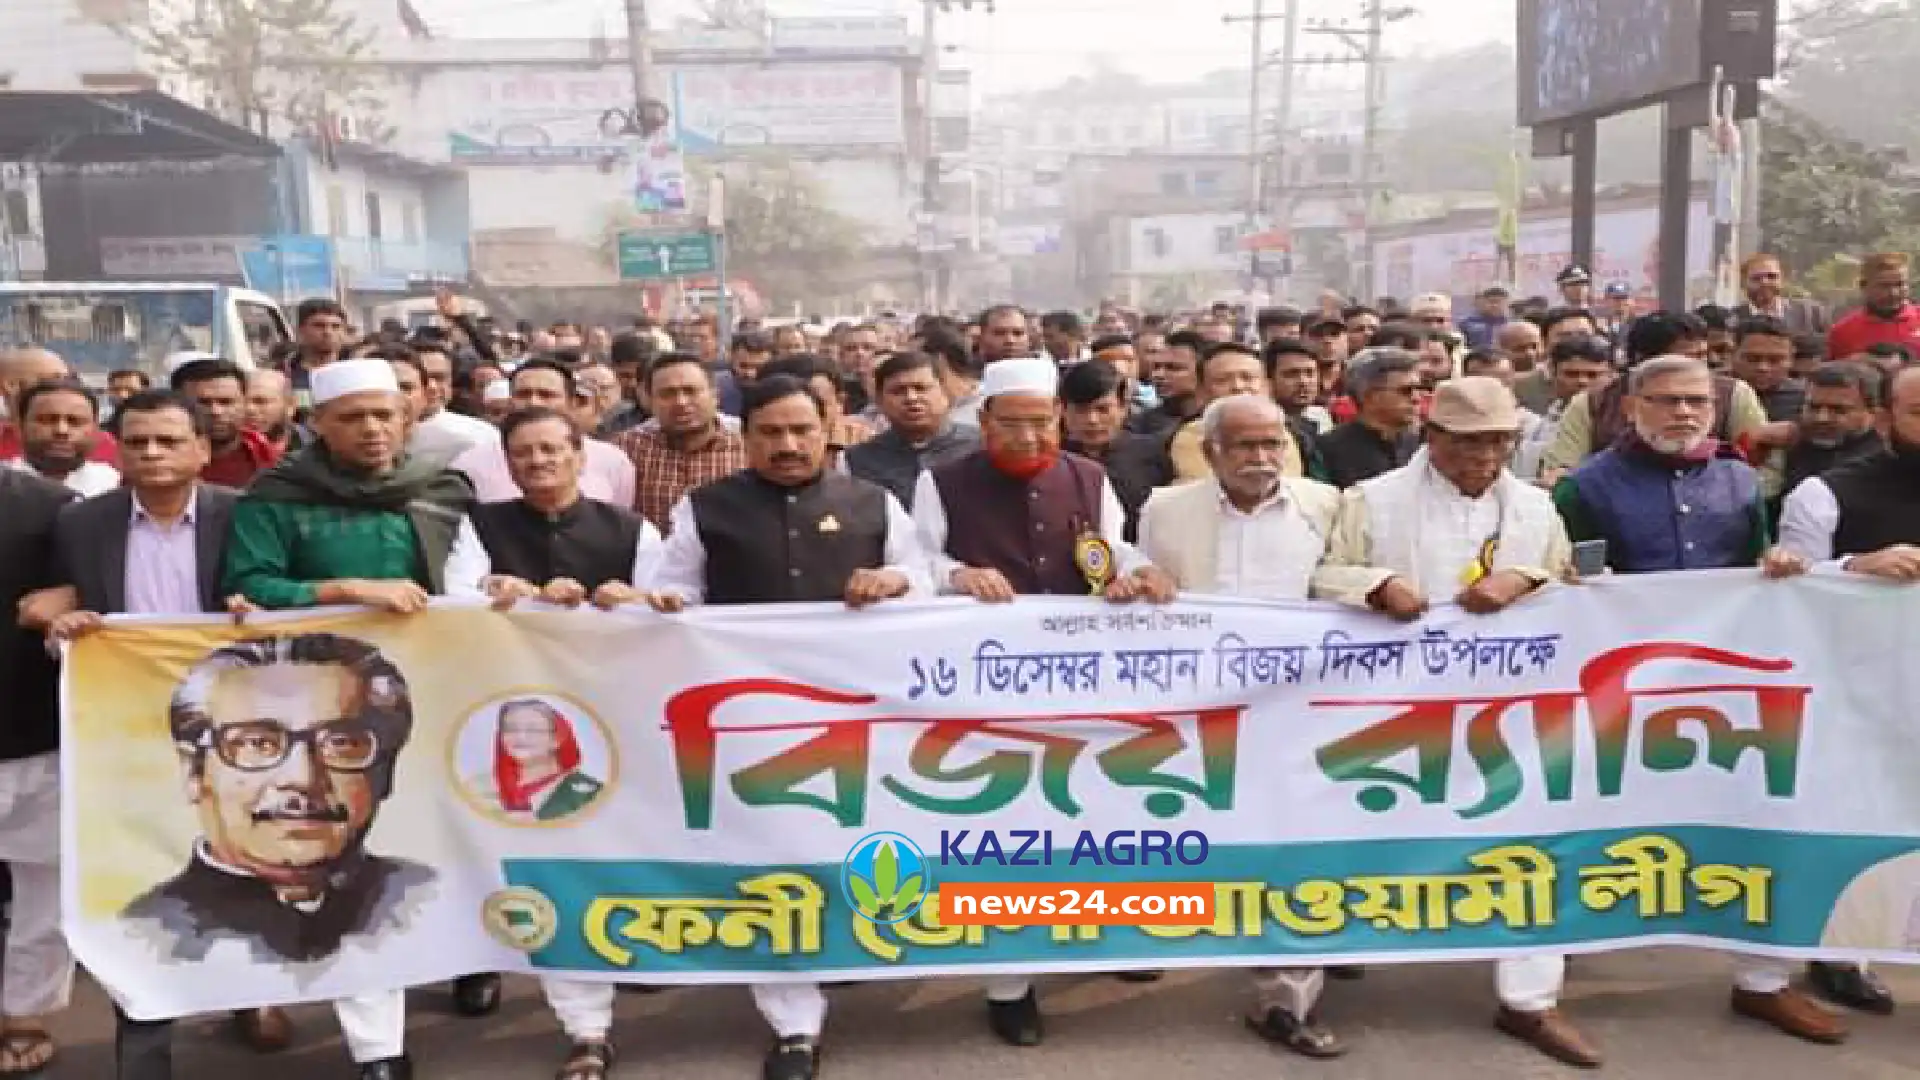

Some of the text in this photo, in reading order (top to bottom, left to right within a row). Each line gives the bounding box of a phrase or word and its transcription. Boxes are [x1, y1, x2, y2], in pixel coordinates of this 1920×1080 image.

[907, 625, 1563, 700] ১৬ ডিসেম্বর মহান বিজয় দিবস উপলক্ষে
[659, 677, 1250, 832] বিজয়
[583, 870, 825, 967] ফেনী
[1578, 833, 1774, 925] লীগ
